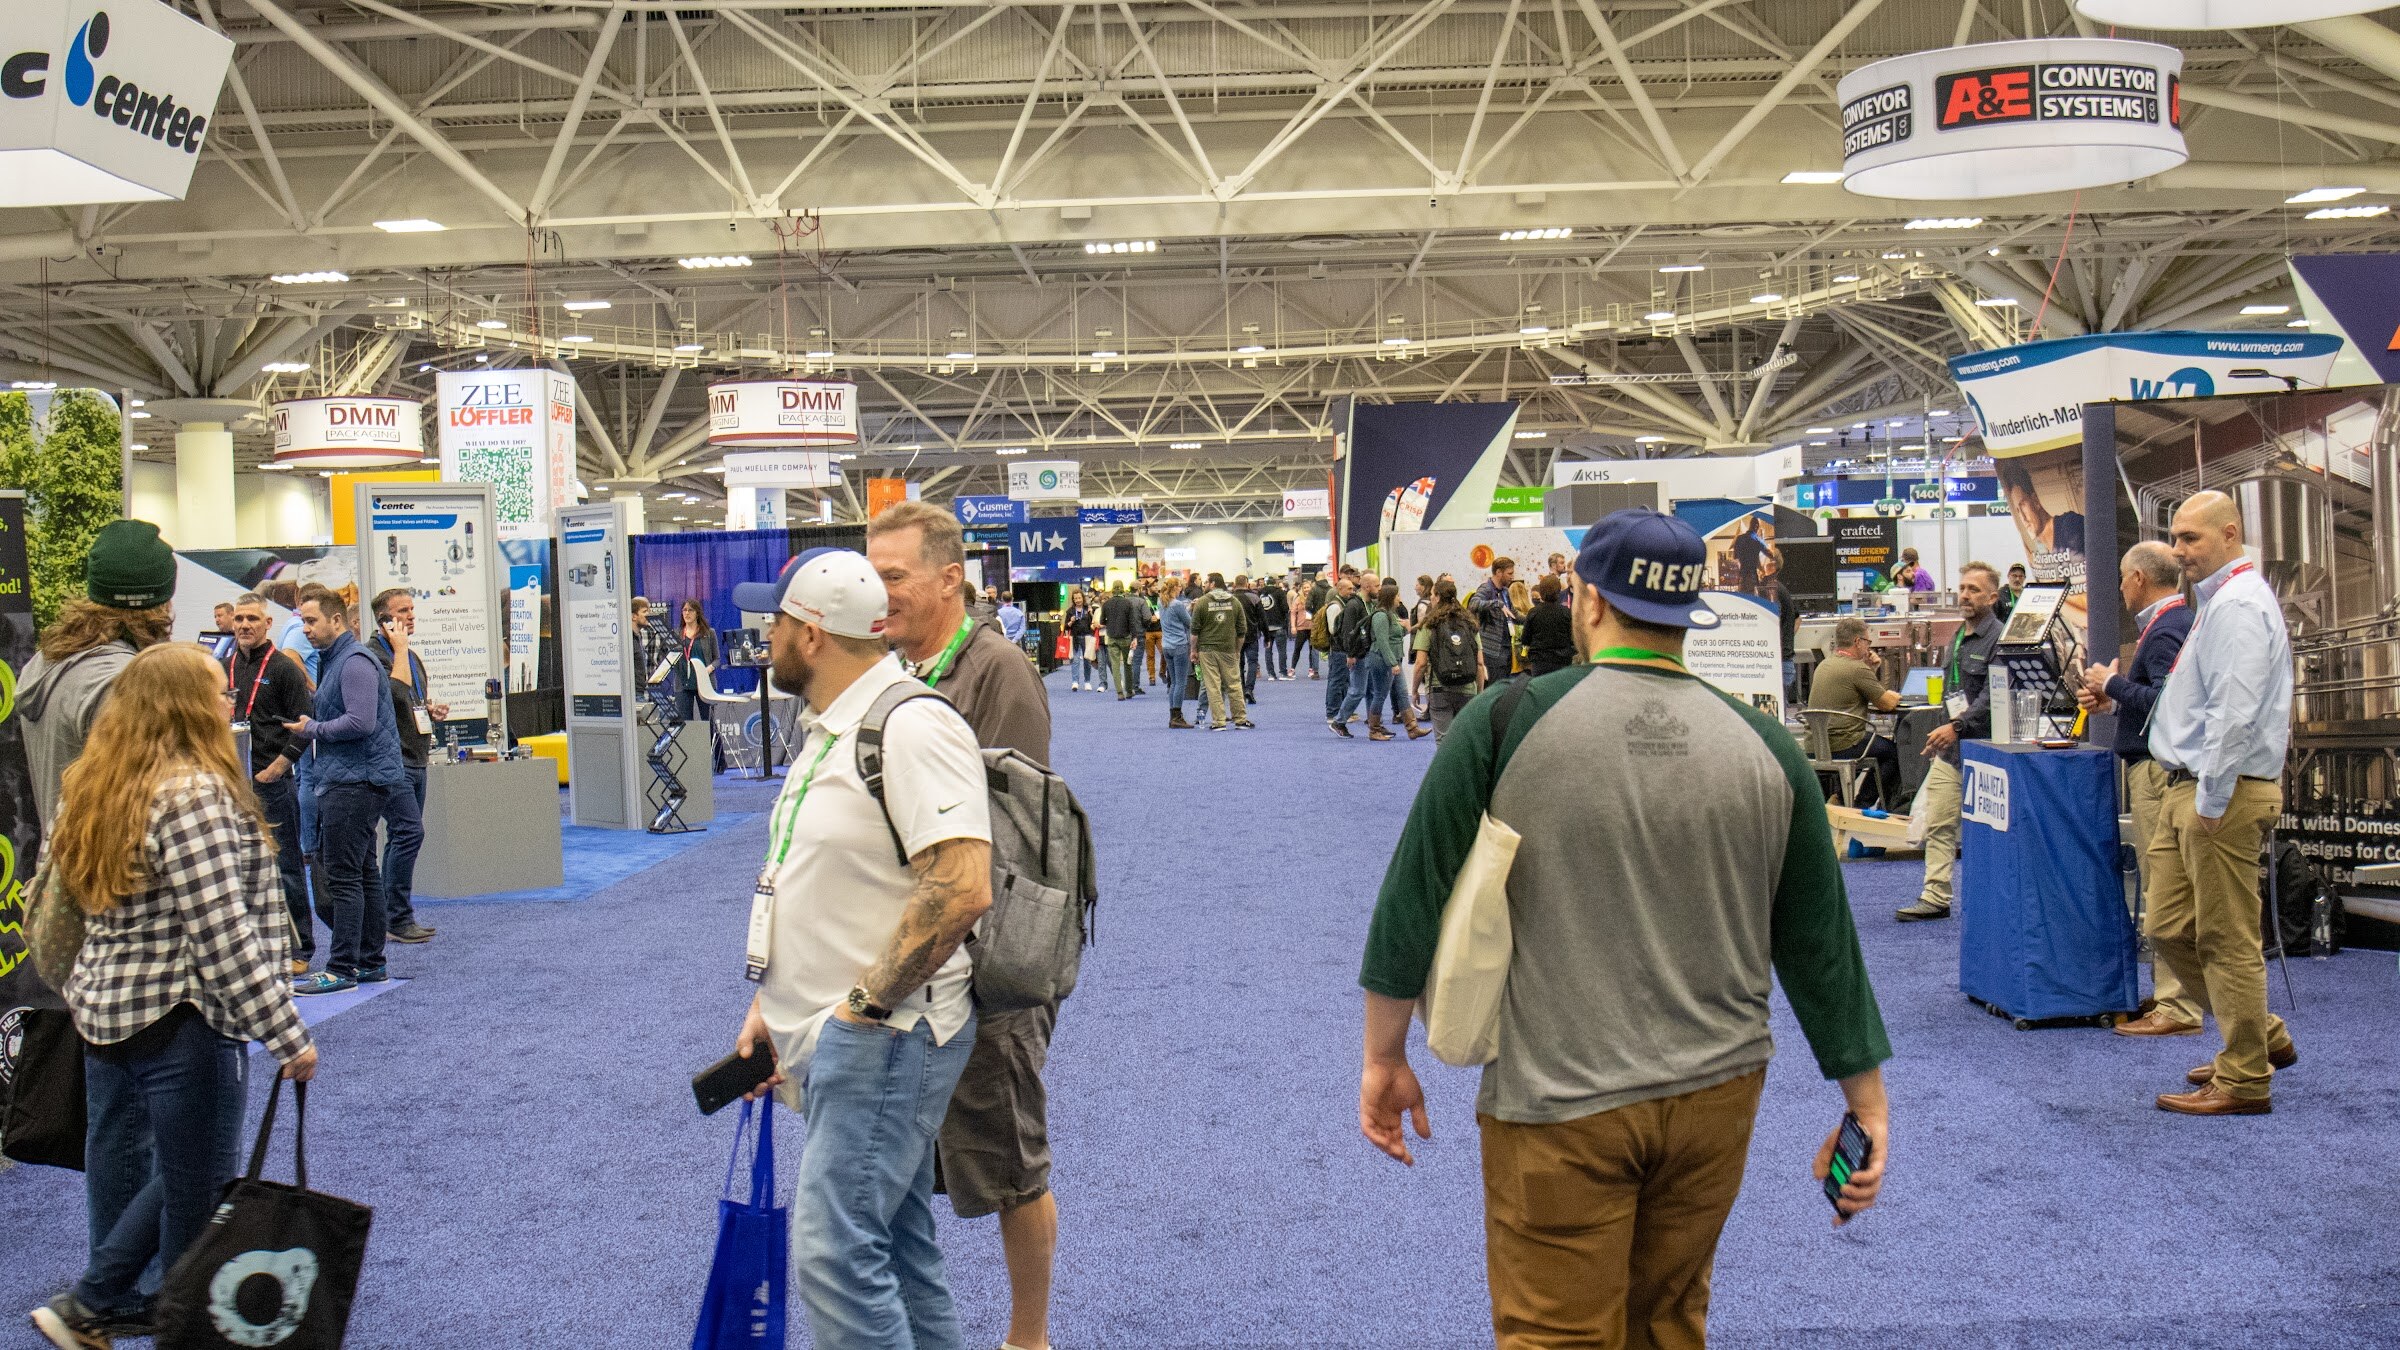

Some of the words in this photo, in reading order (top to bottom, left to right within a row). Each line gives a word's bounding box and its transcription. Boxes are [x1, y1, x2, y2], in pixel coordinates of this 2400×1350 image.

[2042, 66, 2156, 92] CONVEYOR
[1943, 71, 2031, 125] A&E
[1843, 88, 1908, 129] CONVEYOR
[2043, 95, 2143, 119] SYSTEMS
[94, 74, 207, 154] centec
[1843, 120, 1891, 158] SYSTEMS
[2206, 340, 2304, 356] www.wmeng.com
[462, 384, 523, 406] ZEE
[554, 380, 571, 403] ZEE
[782, 390, 842, 411] DMM
[329, 407, 396, 427] DMM
[782, 414, 843, 424] PACKAGING
[329, 429, 398, 440] PACKAGING
[730, 465, 743, 473] PAUL
[781, 463, 818, 472] COMPANY
[1585, 470, 1610, 481] KHS
[382, 502, 415, 510] centec
[760, 501, 773, 514] #1
[978, 502, 1013, 512] Gusmer
[1296, 498, 1323, 507] SCOTT
[1399, 501, 1423, 518] CRISP
[1841, 525, 1884, 536] crafted.
[1860, 546, 1890, 556] EFFICIENCY
[459, 623, 486, 632] Valves
[1692, 639, 1708, 647] OVER
[1709, 639, 1717, 647] 30
[1718, 640, 1741, 648] OFFICES
[1742, 640, 1756, 648] AND
[1756, 640, 1769, 648] 400
[424, 647, 460, 658] Butterfly
[461, 646, 487, 655] Valves
[1688, 650, 1726, 659] ENGINEERING
[1727, 651, 1775, 660] PROFESSIONALS
[590, 659, 619, 667] Concentration
[1727, 662, 1745, 670] Process
[432, 674, 452, 682] Project
[452, 671, 487, 681] Management
[438, 689, 465, 699] Vacuum
[2302, 815, 2341, 832] with
[2356, 842, 2382, 859] for
